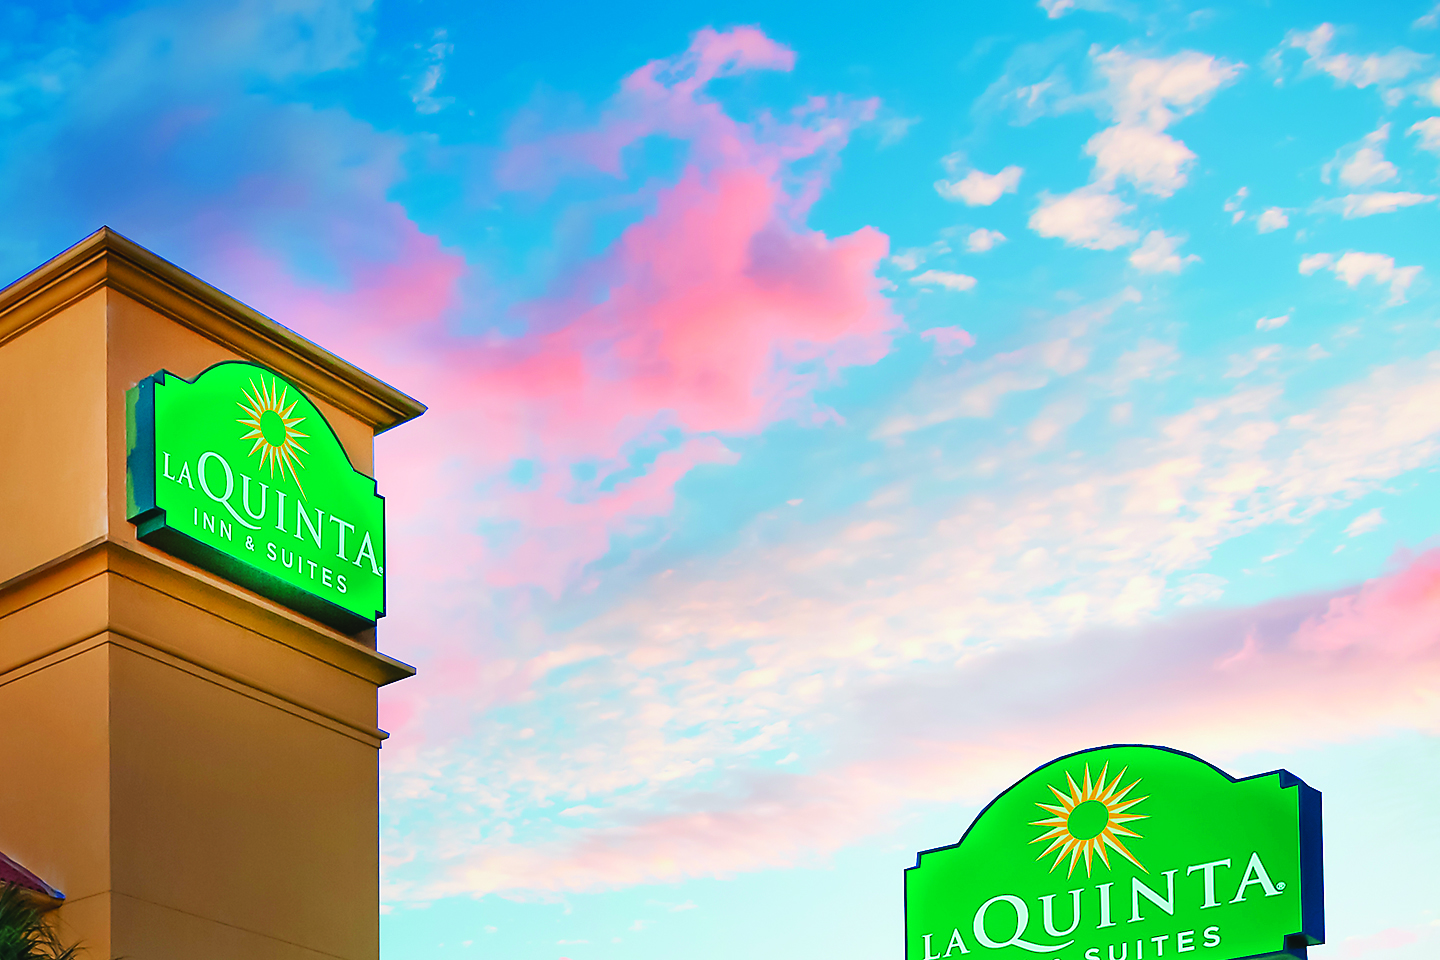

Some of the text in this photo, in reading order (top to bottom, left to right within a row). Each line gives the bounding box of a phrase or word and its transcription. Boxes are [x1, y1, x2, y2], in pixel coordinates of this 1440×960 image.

[162, 451, 195, 490] LA
[193, 507, 348, 594] INN & SUITES
